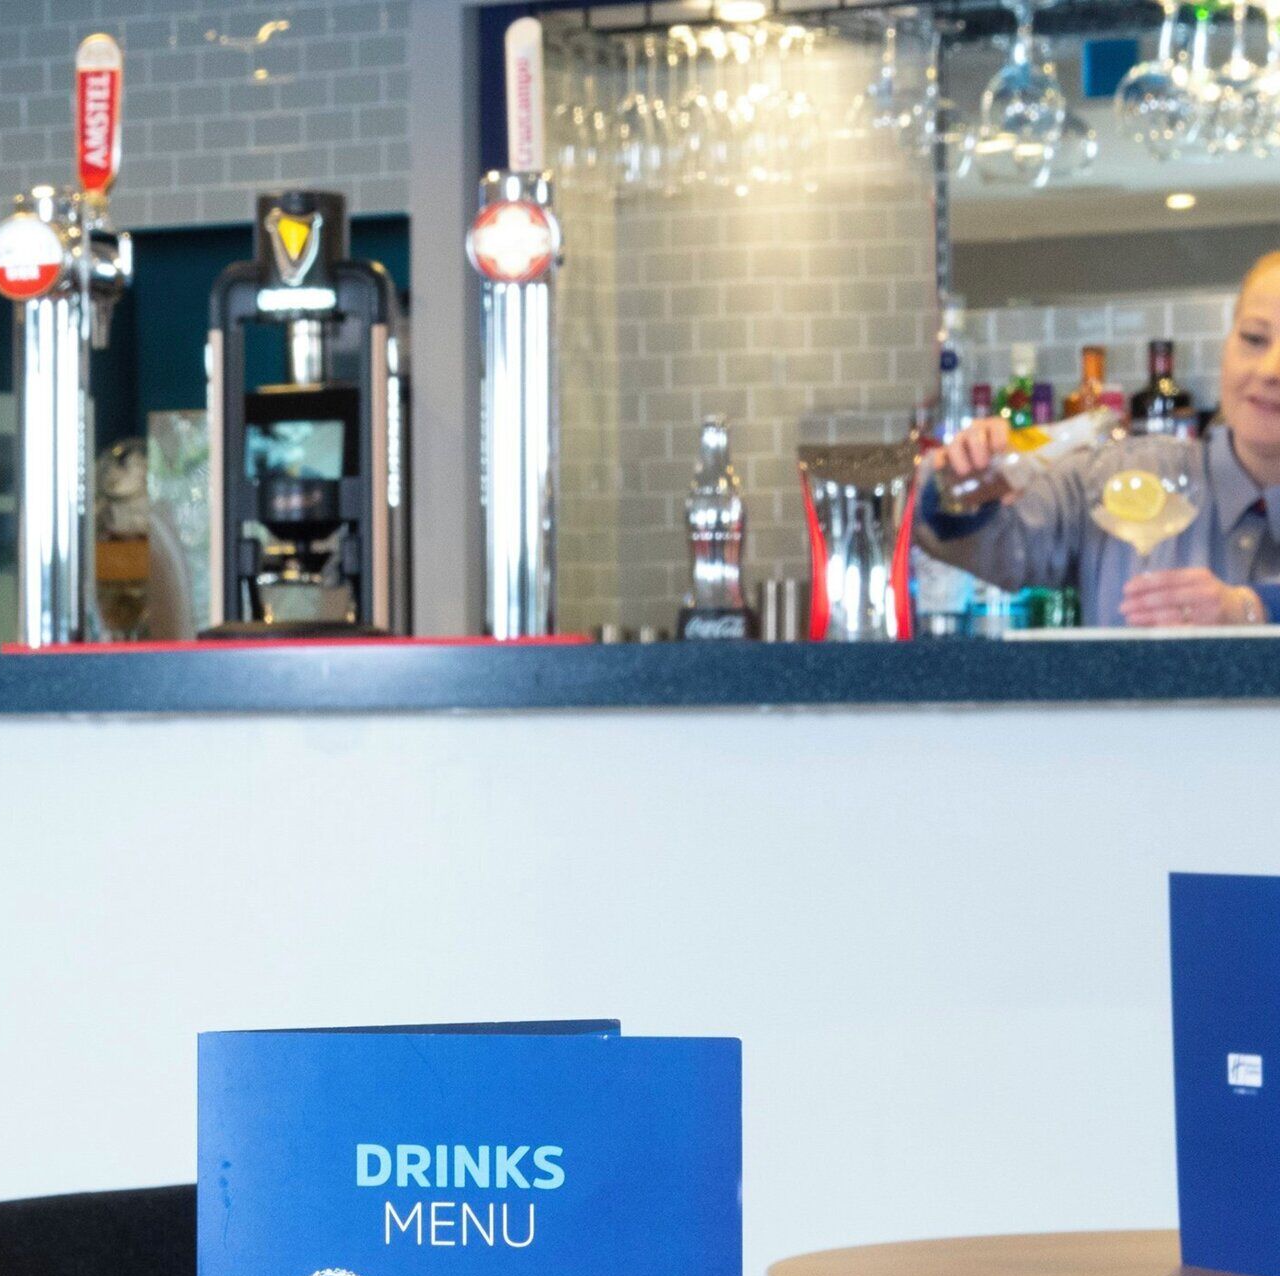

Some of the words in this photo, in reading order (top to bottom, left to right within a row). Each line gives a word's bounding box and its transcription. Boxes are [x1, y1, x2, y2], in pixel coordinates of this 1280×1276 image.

[85, 71, 111, 168] AMSTEL
[356, 1143, 566, 1190] DRINKS
[385, 1200, 535, 1248] MENU
